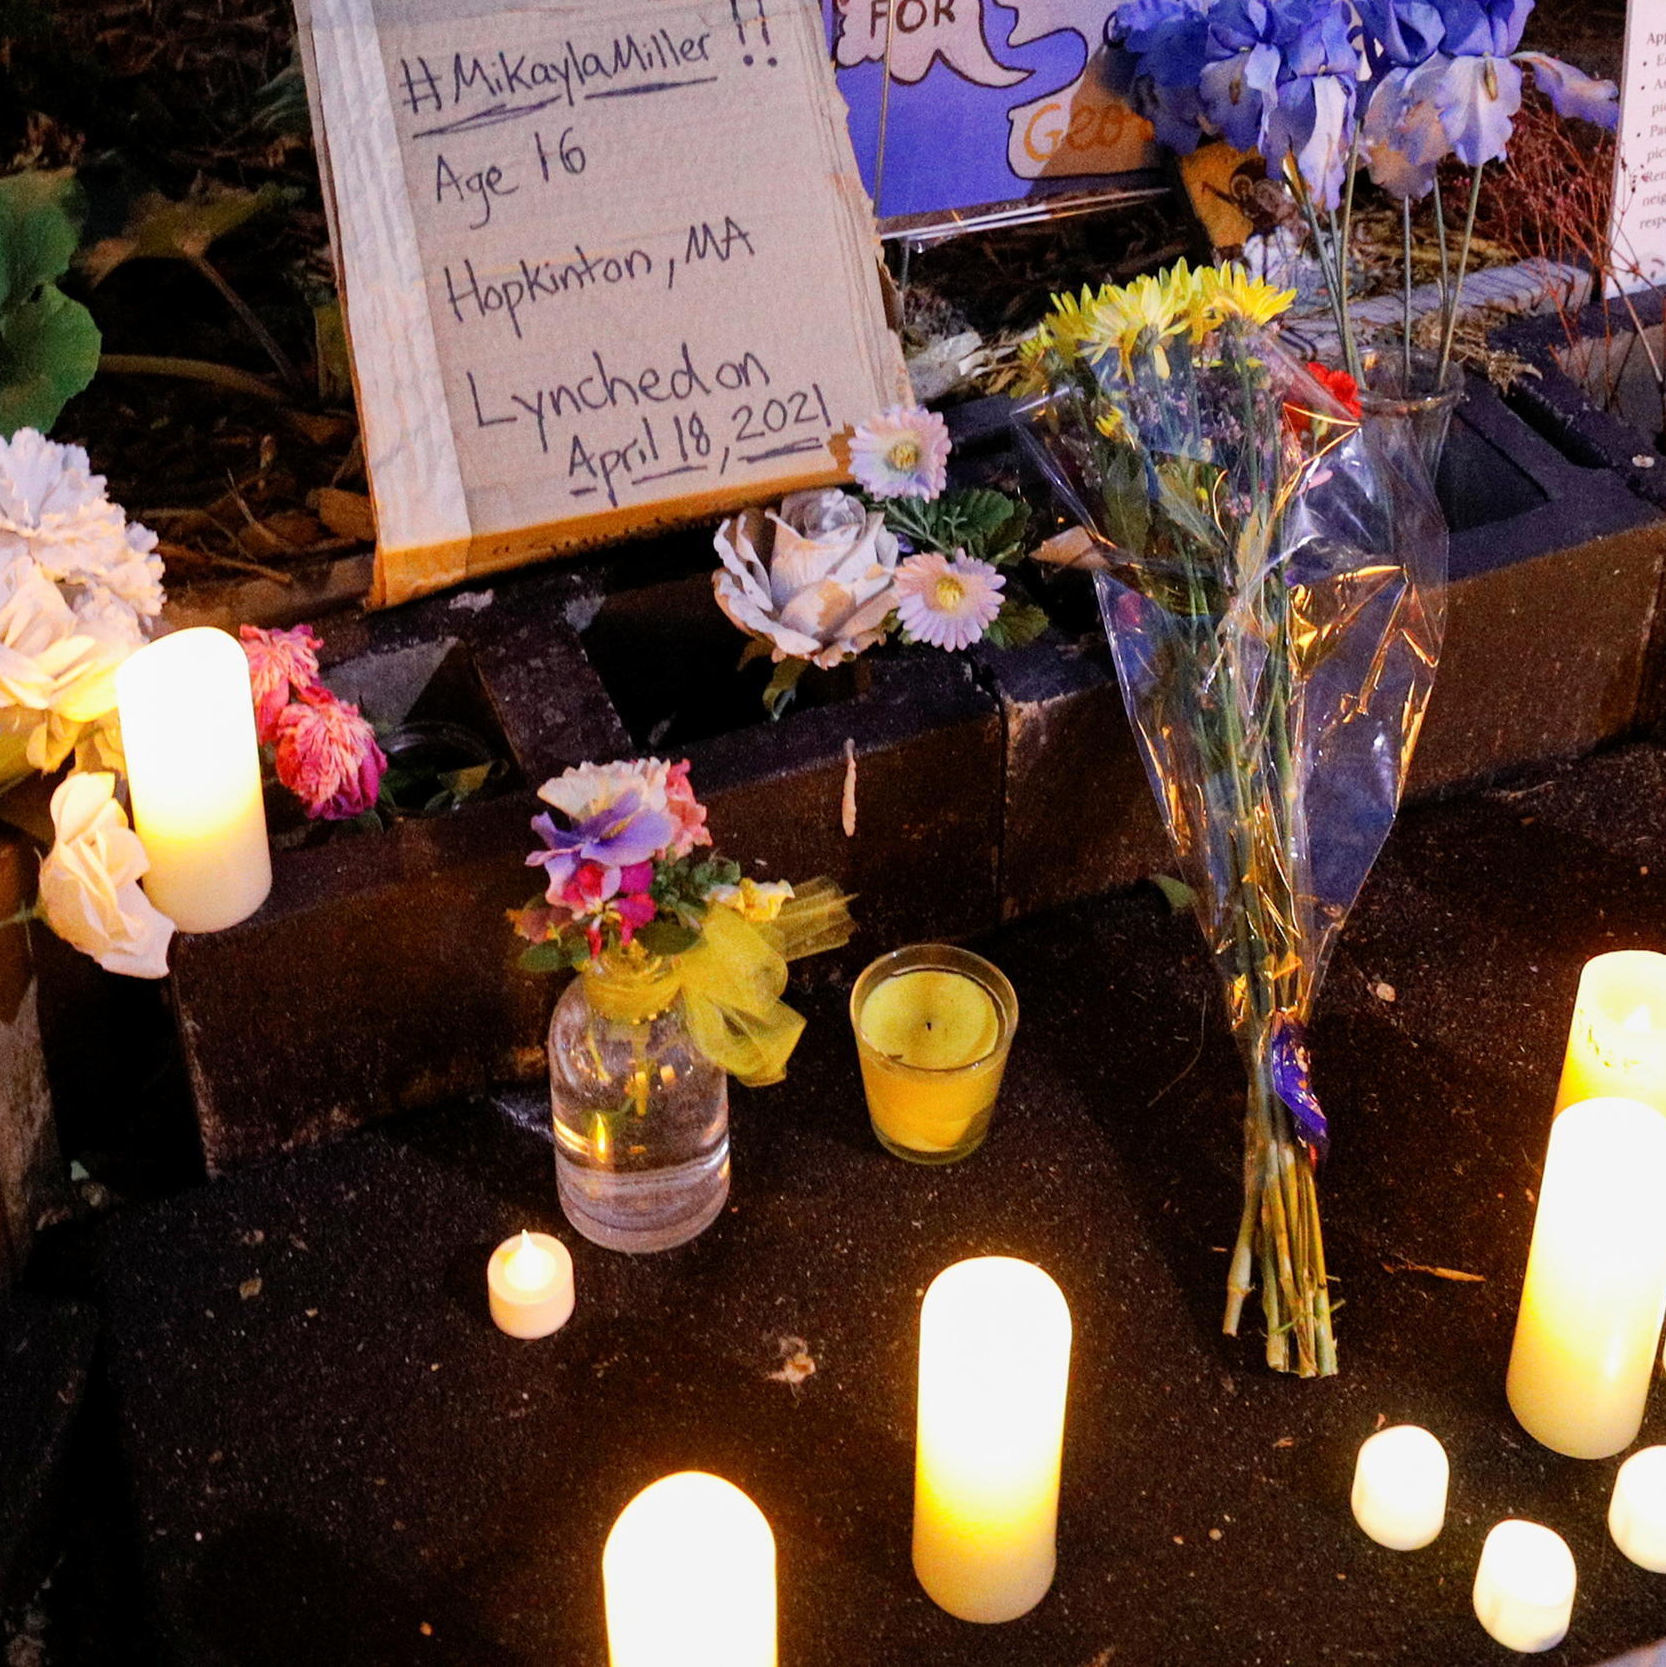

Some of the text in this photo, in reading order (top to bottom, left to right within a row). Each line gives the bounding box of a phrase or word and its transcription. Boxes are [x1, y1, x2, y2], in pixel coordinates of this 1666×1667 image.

[436, 127, 587, 230] Age 16
[686, 216, 755, 264] MA
[467, 342, 770, 453] Lynched on
[569, 417, 659, 507] April
[732, 383, 832, 442] 2021
